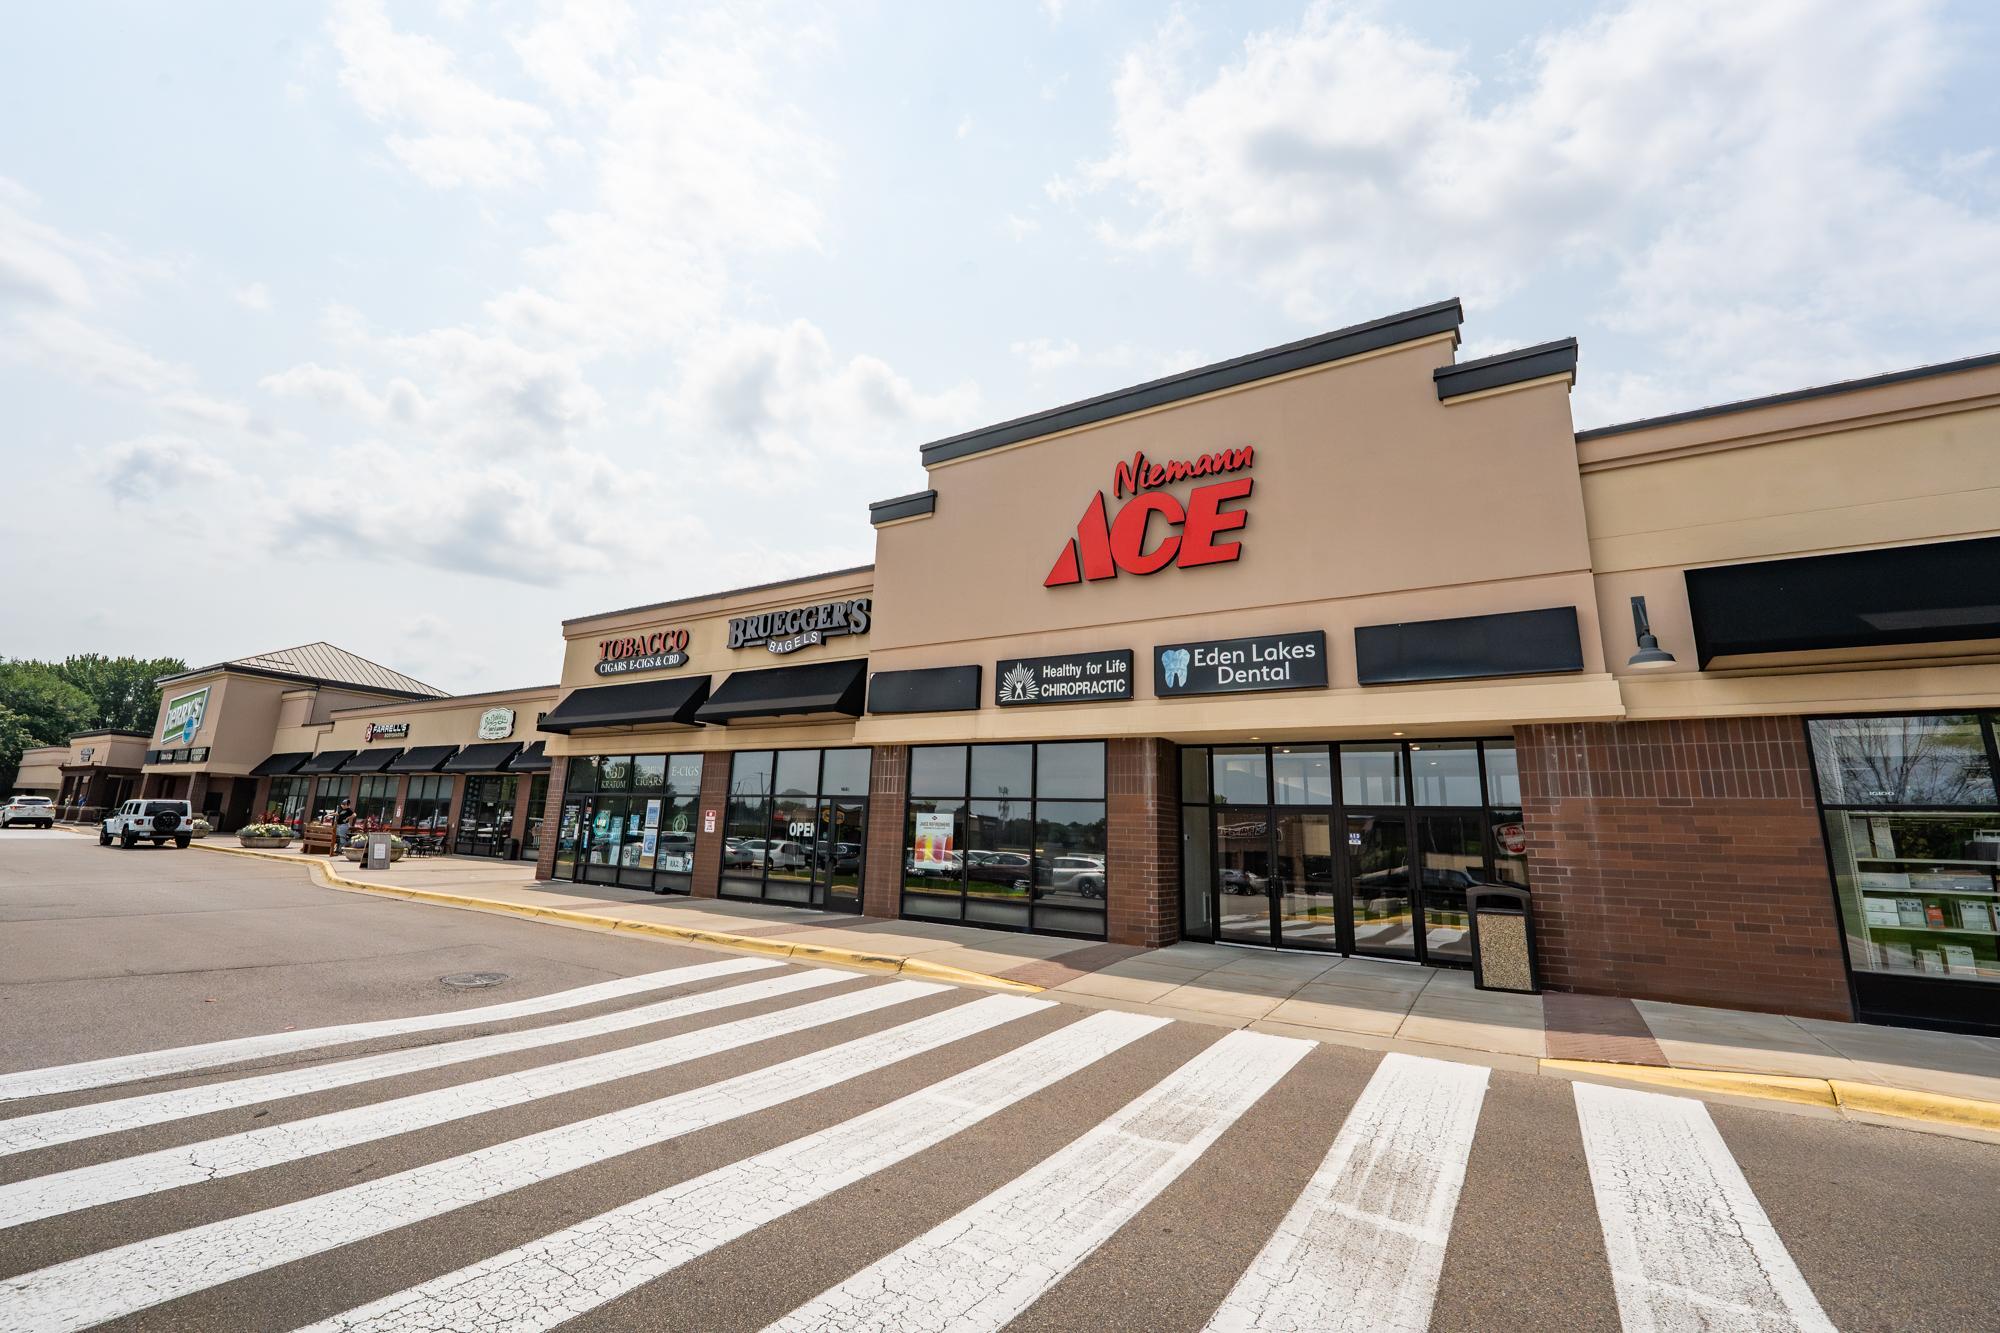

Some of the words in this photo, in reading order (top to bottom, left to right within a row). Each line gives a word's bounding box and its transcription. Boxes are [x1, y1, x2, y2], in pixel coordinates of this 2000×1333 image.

[1113, 445, 1254, 499] Niemann
[1043, 477, 1254, 588] ACE
[727, 598, 872, 649] BRUEGGER'S
[600, 629, 689, 660] TOBACCO
[768, 631, 818, 653] BAGELS
[600, 661, 627, 673] CIGARS
[629, 657, 654, 670] E-CIGS
[655, 656, 661, 666] &
[663, 654, 679, 666] CBD
[1194, 647, 1245, 667] Eden
[1252, 641, 1316, 662] Lakes
[1042, 663, 1082, 678] Healthy
[1086, 662, 1102, 675] for
[1106, 659, 1126, 673] Life
[1218, 661, 1290, 684] Dental
[1041, 679, 1125, 697] CHIROPRACTIC
[605, 766, 625, 779] CBD
[635, 776, 663, 786] CIGARS
[672, 765, 699, 777] E-CIGS
